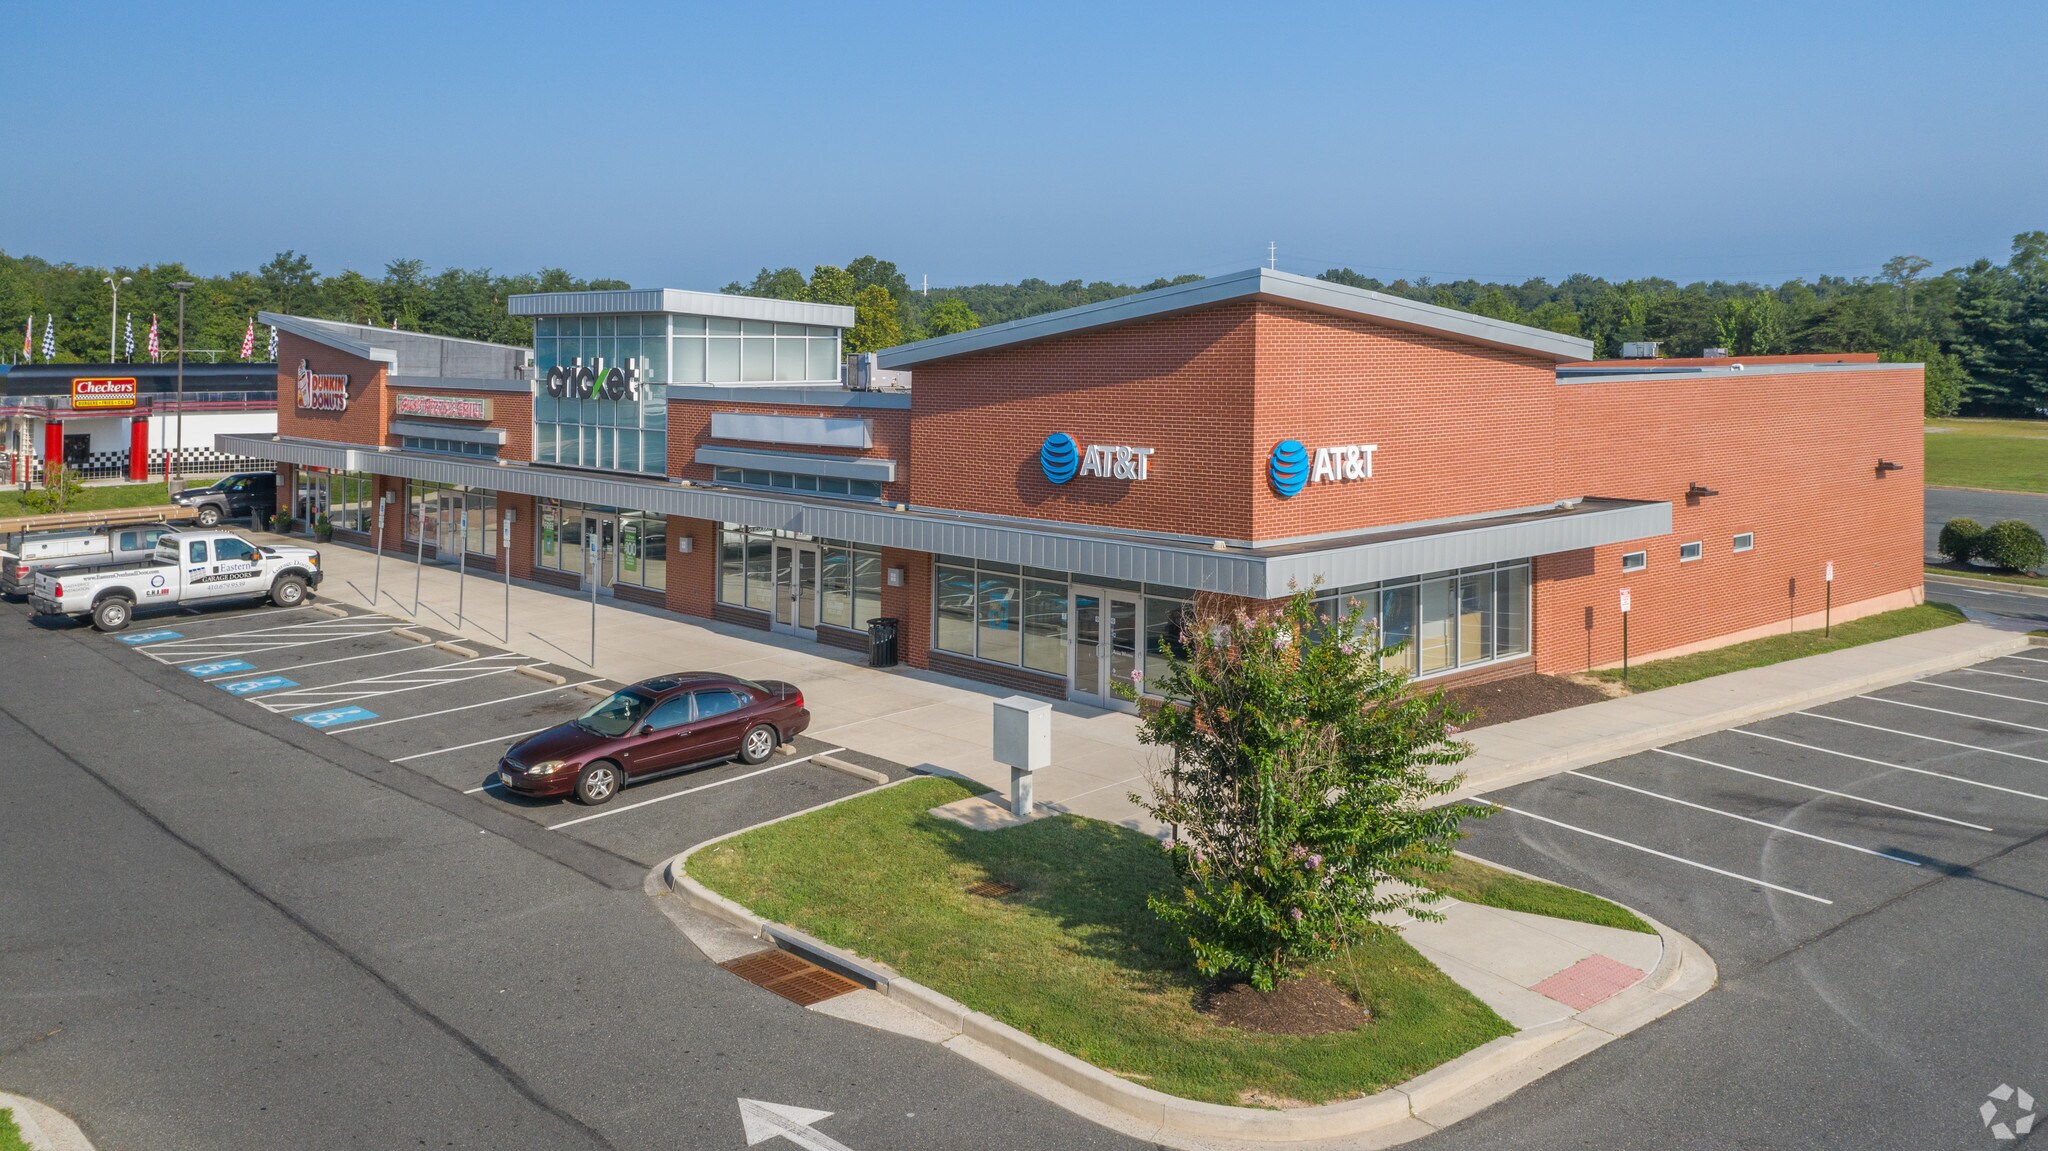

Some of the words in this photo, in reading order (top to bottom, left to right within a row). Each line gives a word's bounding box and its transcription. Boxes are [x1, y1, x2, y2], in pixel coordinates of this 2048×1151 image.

[547, 357, 639, 401] cricket
[77, 381, 133, 393] Checkers
[312, 392, 346, 410] DONUTS
[1080, 445, 1154, 480] AT&T
[1311, 444, 1377, 482] AT&T
[220, 562, 251, 572] Eastern
[294, 560, 311, 570] Doors
[202, 573, 229, 583] GARAGE
[229, 572, 252, 580] DOORS
